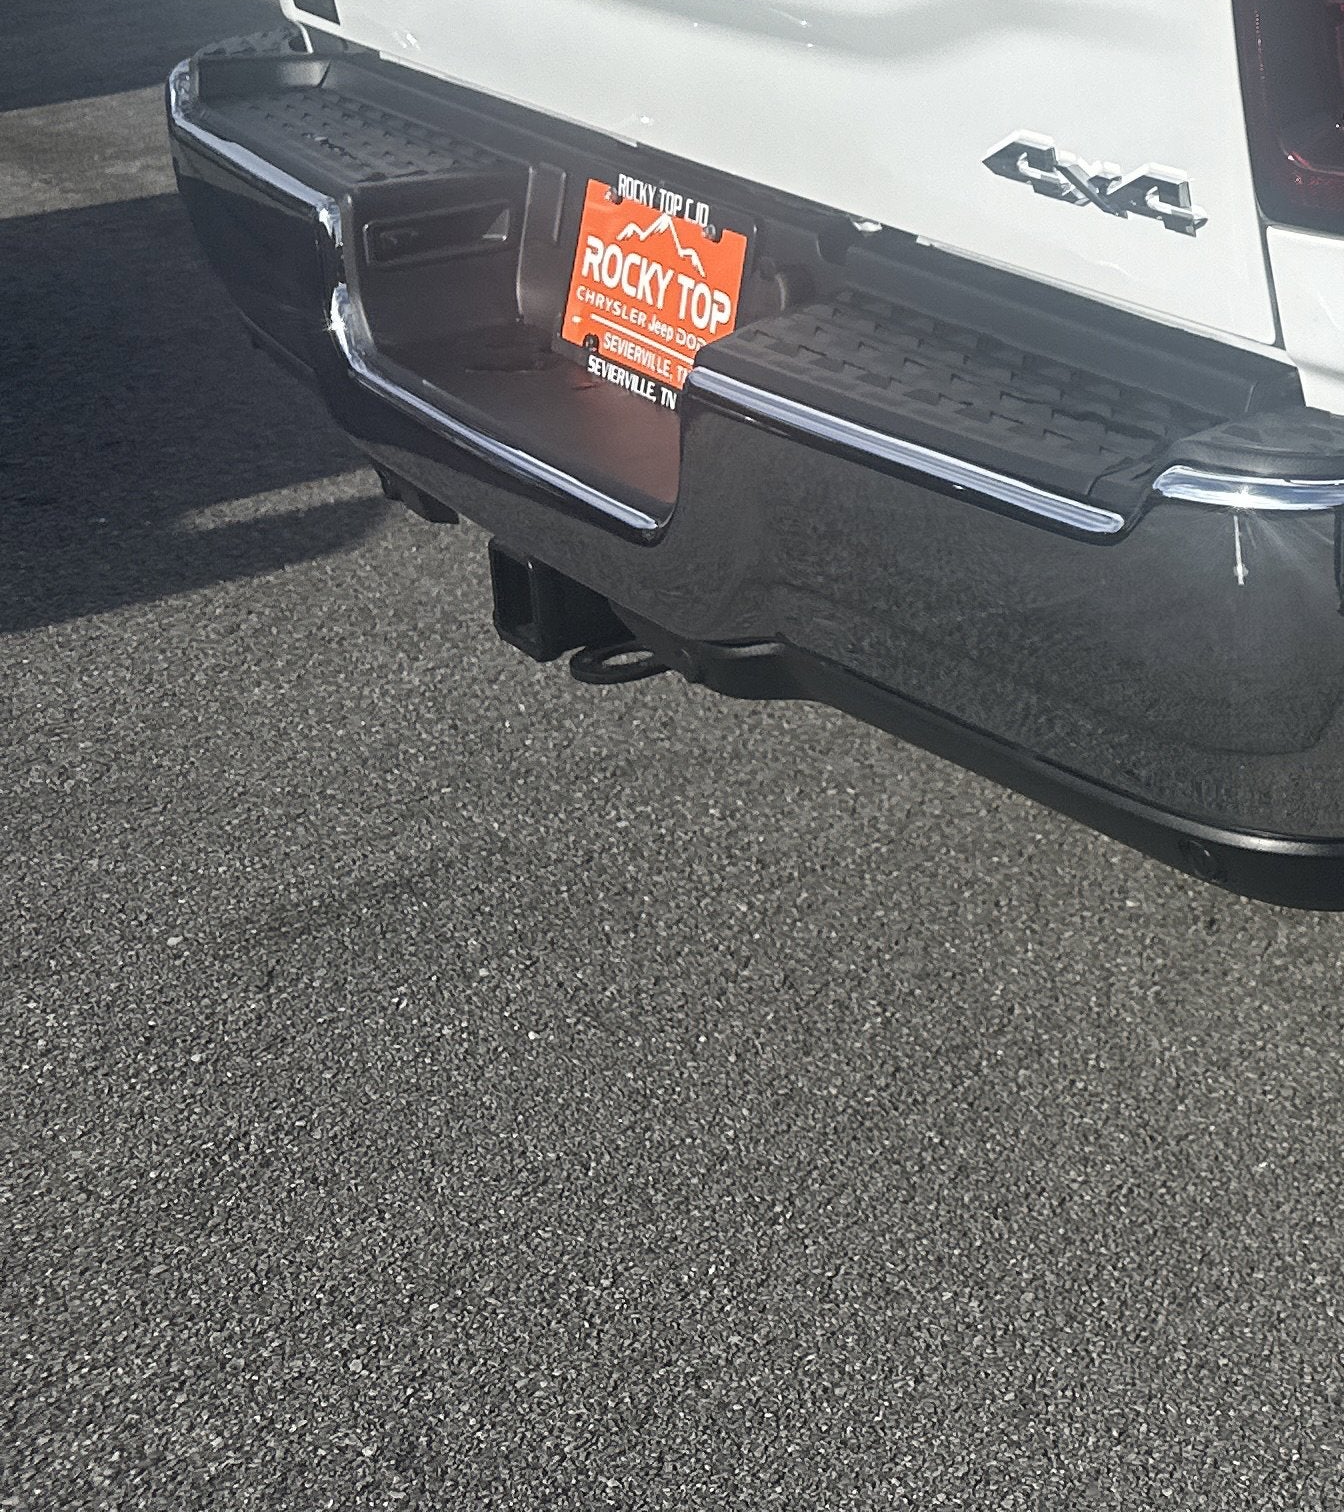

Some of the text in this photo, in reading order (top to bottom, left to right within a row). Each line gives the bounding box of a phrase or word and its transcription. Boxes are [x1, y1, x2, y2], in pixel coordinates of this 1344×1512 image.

[617, 173, 656, 210] ROCKY
[659, 188, 683, 217] TOP
[576, 285, 648, 329] CHRYSLER
[648, 314, 675, 343] Jeep
[581, 236, 732, 335] ROCKY TOP
[587, 354, 677, 411] SEVIERVILLE, TN
[603, 331, 674, 381] SEVIERVILLE,
